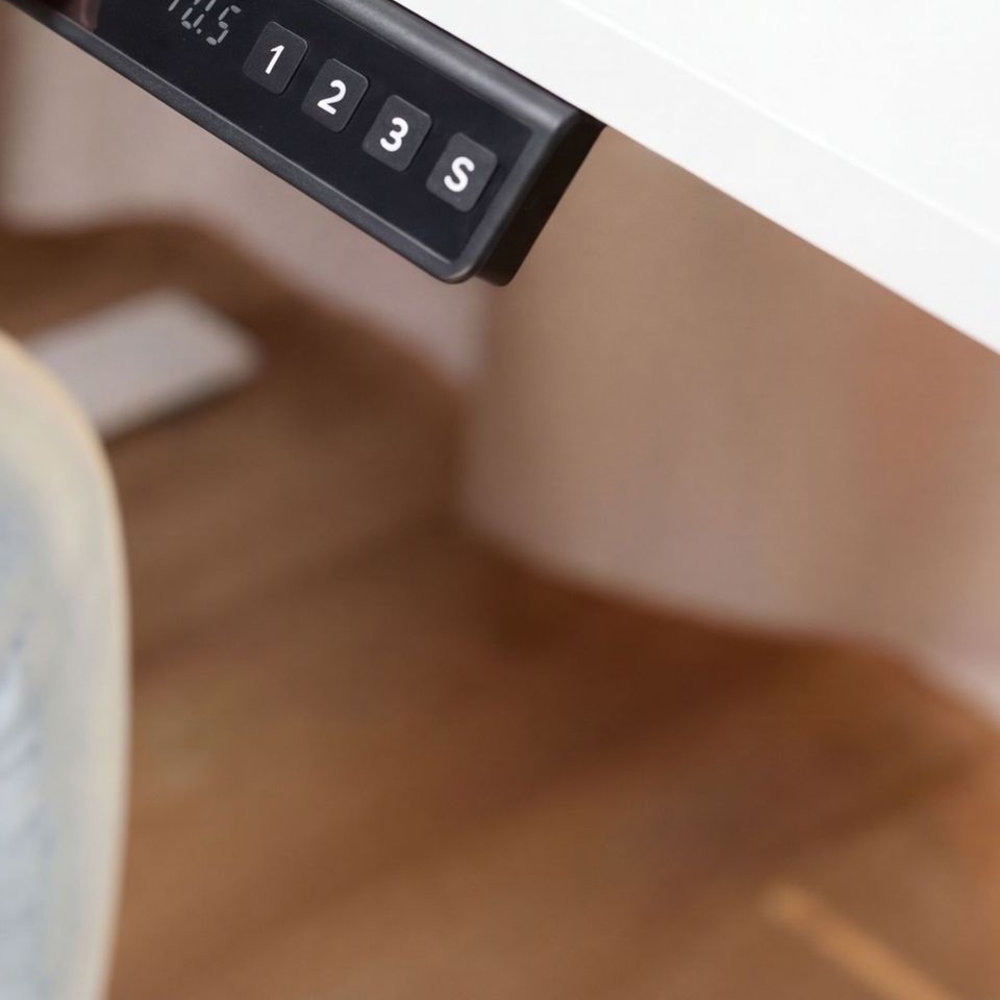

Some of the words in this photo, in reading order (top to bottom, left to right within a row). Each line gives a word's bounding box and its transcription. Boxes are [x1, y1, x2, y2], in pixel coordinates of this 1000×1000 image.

[264, 44, 285, 75] 1
[316, 79, 347, 115] 2
[379, 116, 409, 153] 3
[443, 155, 476, 193] S
